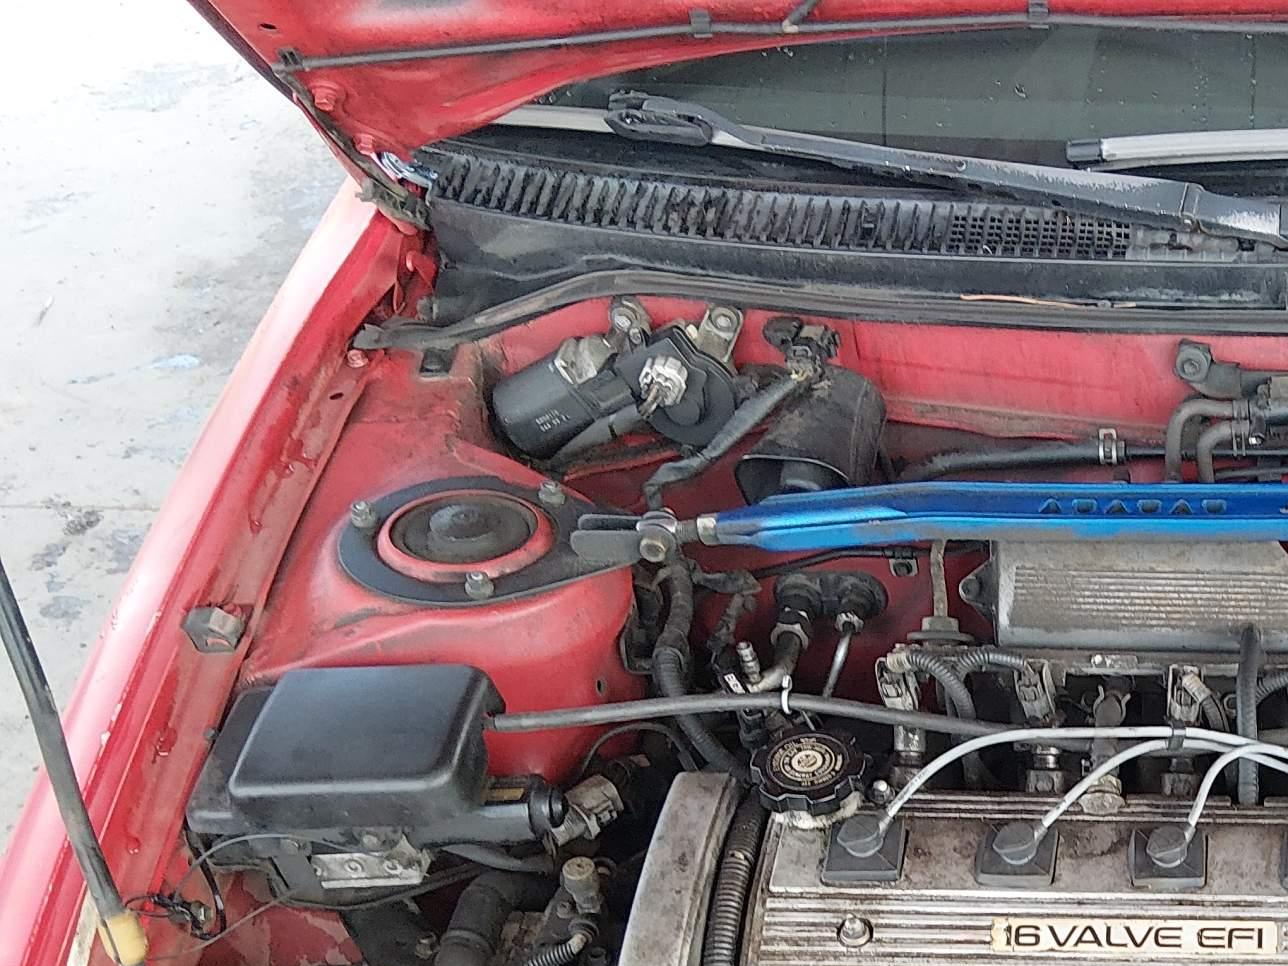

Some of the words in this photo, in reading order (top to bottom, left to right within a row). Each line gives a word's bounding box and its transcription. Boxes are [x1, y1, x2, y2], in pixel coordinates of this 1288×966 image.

[1004, 924, 1041, 949] 16
[1046, 925, 1183, 950] VALVE
[1197, 927, 1266, 950] EFI
